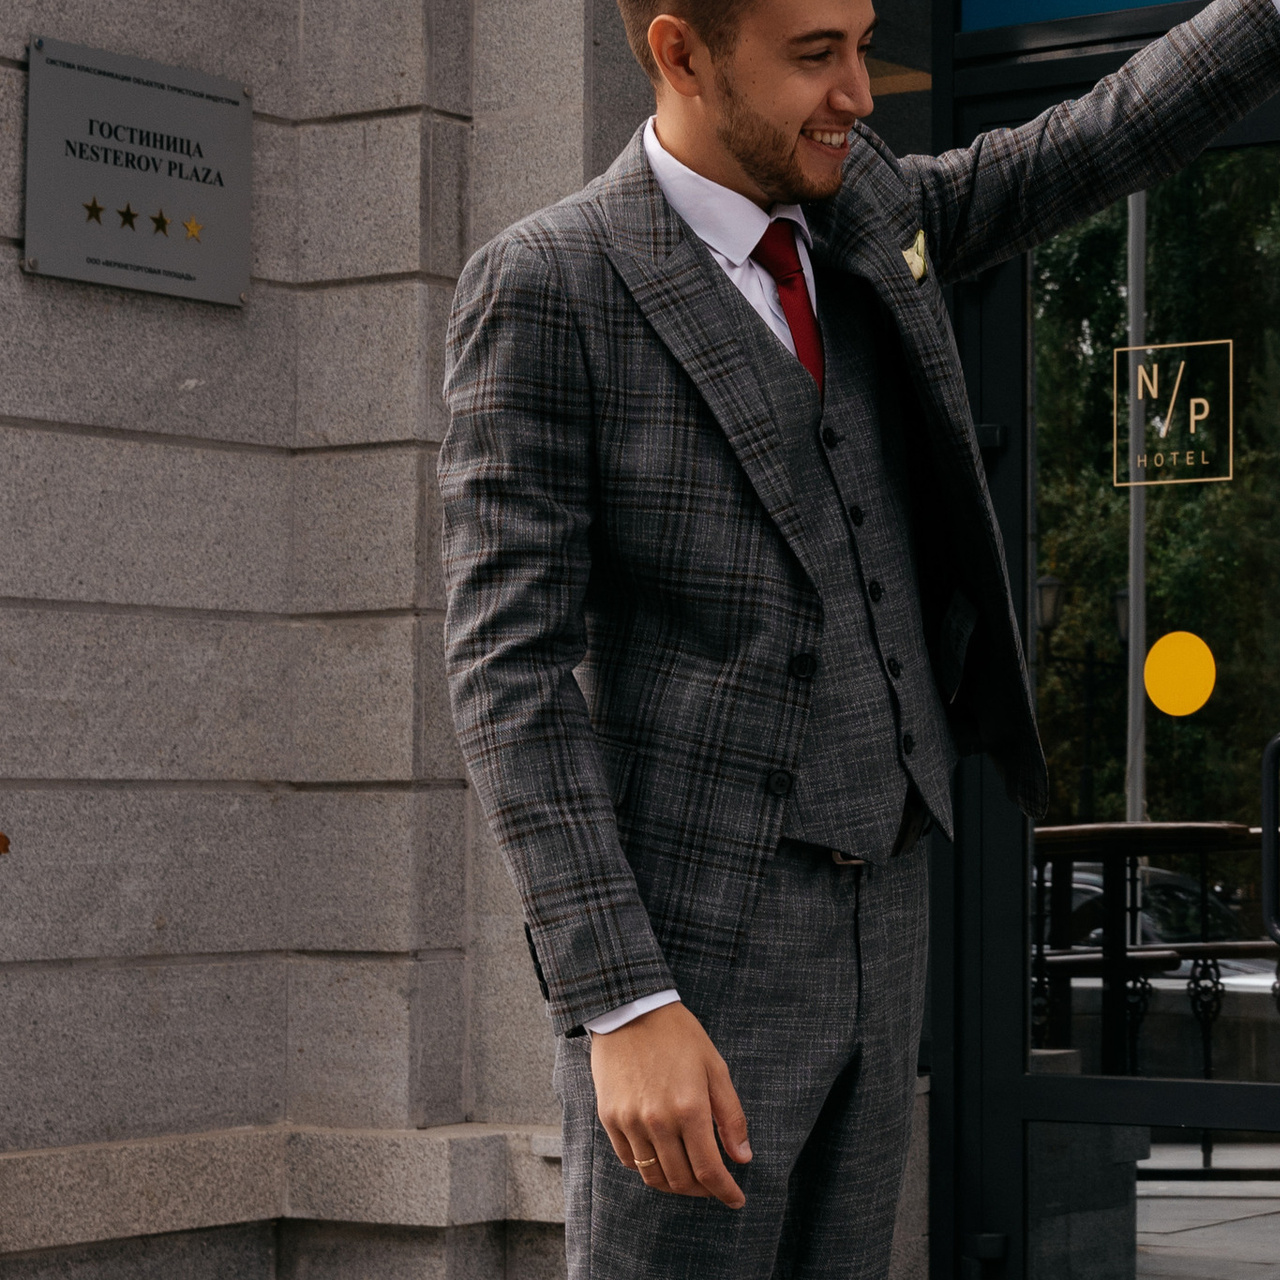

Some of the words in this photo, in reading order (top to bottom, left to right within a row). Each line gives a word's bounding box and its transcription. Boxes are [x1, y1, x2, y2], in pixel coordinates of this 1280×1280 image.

[88, 118, 204, 159] ГОСТИНИЦА
[64, 139, 163, 174] NESTEROV
[167, 160, 225, 187] PLAZA
[1137, 450, 1210, 468] HOTEL
